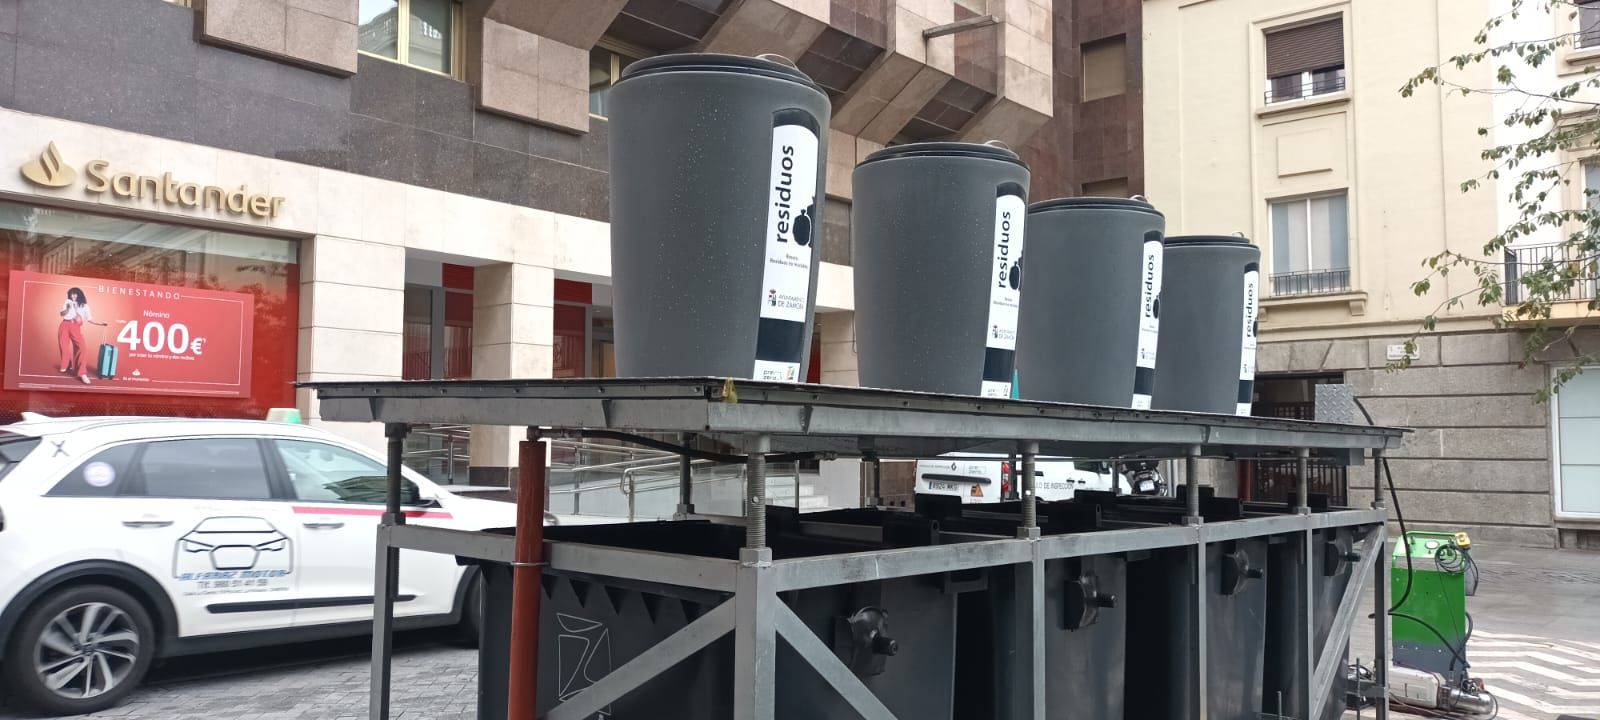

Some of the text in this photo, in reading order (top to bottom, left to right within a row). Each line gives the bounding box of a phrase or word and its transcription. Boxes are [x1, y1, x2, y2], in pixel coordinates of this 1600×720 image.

[85, 159, 286, 219] Santander
[775, 144, 794, 243] residuos
[997, 210, 1011, 289] residuos
[98, 283, 181, 300] BIENESTANDO
[143, 310, 170, 319] Nómina
[1144, 253, 1155, 319] residuos
[1245, 282, 1254, 338] residuos
